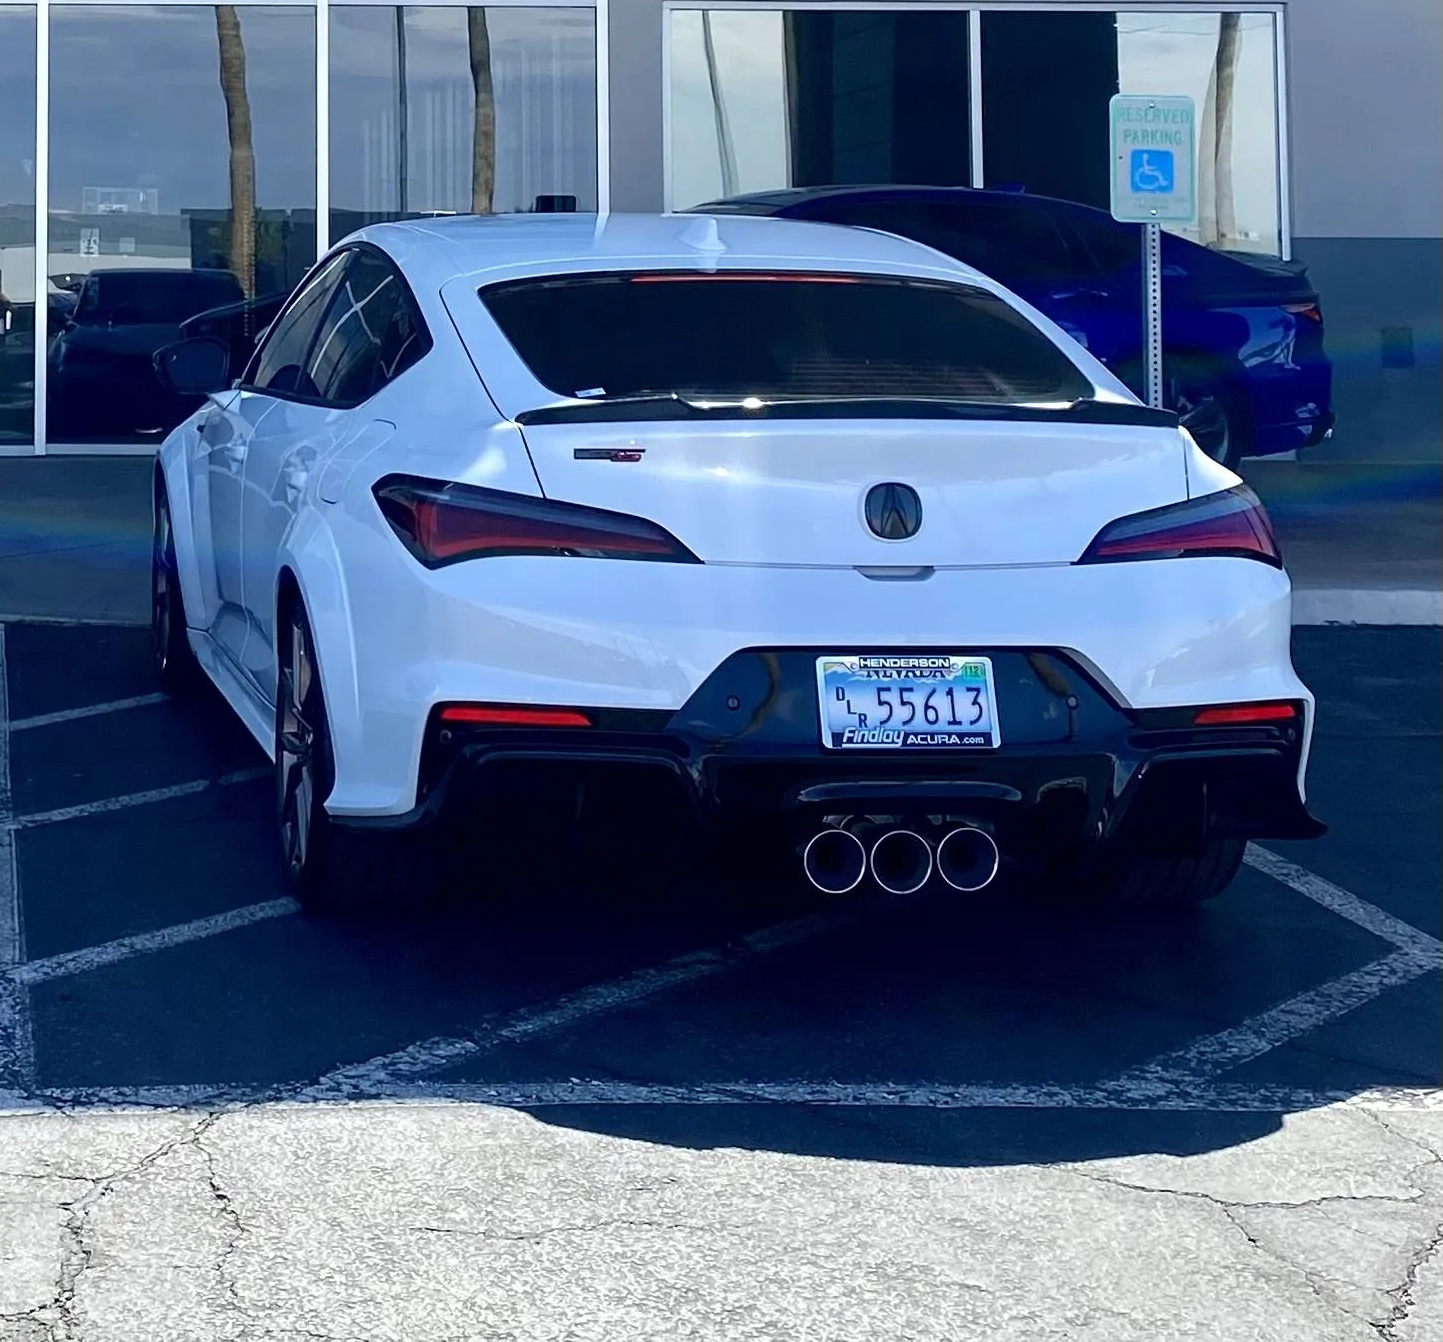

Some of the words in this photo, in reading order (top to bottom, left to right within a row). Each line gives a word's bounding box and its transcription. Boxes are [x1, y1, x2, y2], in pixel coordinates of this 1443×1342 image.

[1118, 107, 1189, 124] RESERVED
[1123, 128, 1183, 145] PARKING
[860, 658, 950, 668] HENDERSON
[969, 666, 981, 676] 12
[877, 687, 983, 727] 55613
[842, 727, 905, 747] Findlay
